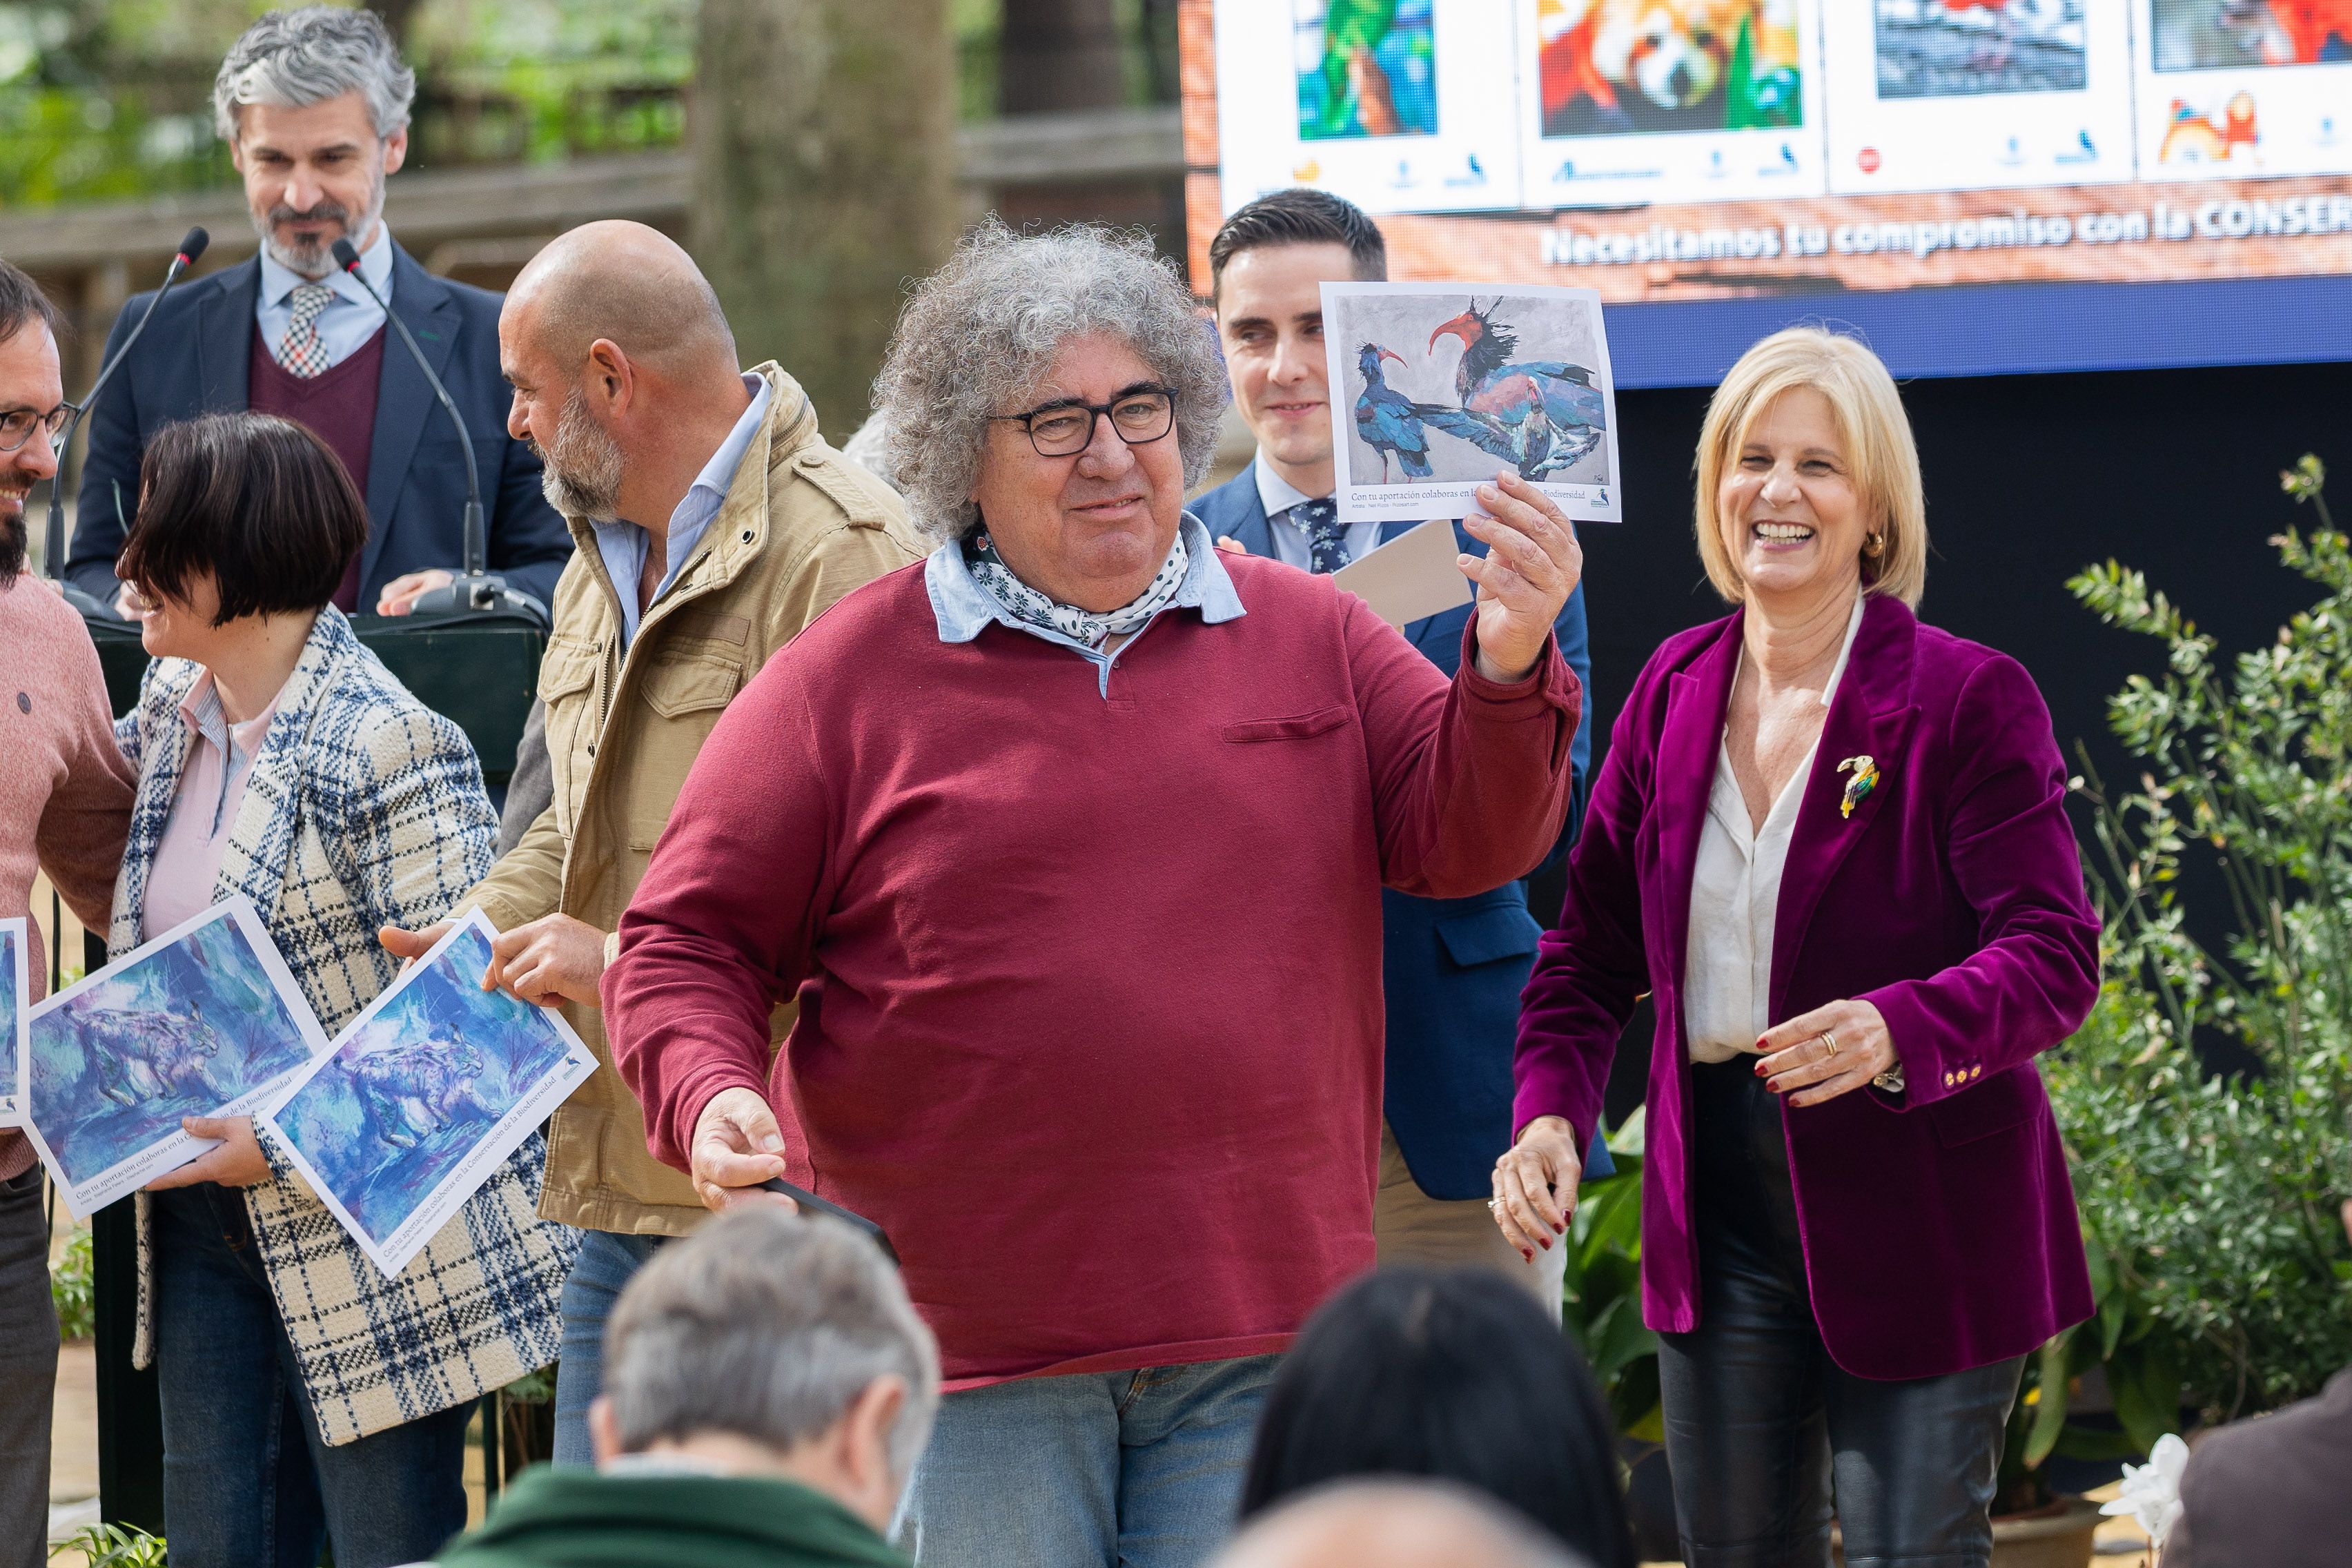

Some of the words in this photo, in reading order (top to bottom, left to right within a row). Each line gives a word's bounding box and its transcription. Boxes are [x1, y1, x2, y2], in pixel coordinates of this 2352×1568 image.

[1541, 223, 1782, 266] Necesitamos
[1785, 222, 1828, 257] tu
[1833, 207, 2071, 259] compromiso
[2077, 212, 2148, 244] con
[2153, 201, 2193, 242] la
[1352, 493, 1367, 501] Con
[1379, 491, 1420, 502] aportación
[1422, 489, 1458, 498] colaboras
[1543, 489, 1585, 499] Biodiversidad
[237, 1102, 246, 1110] la
[245, 1077, 293, 1106] Biodiversidad
[76, 1188, 91, 1200] Con
[90, 1184, 99, 1192] tu
[100, 1164, 136, 1188] aportación
[135, 1147, 168, 1167] colaboras
[168, 1141, 177, 1150] en
[176, 1136, 184, 1144] la
[382, 1244, 397, 1258] Con
[395, 1237, 403, 1246] tu
[401, 1207, 432, 1239] aportación
[429, 1180, 456, 1209] colaboras
[454, 1173, 464, 1182] en
[460, 1166, 469, 1175] la
[466, 1128, 505, 1168] Conservación
[502, 1121, 513, 1131] de
[509, 1115, 518, 1124] la
[516, 1076, 557, 1117] Biodiversidad
